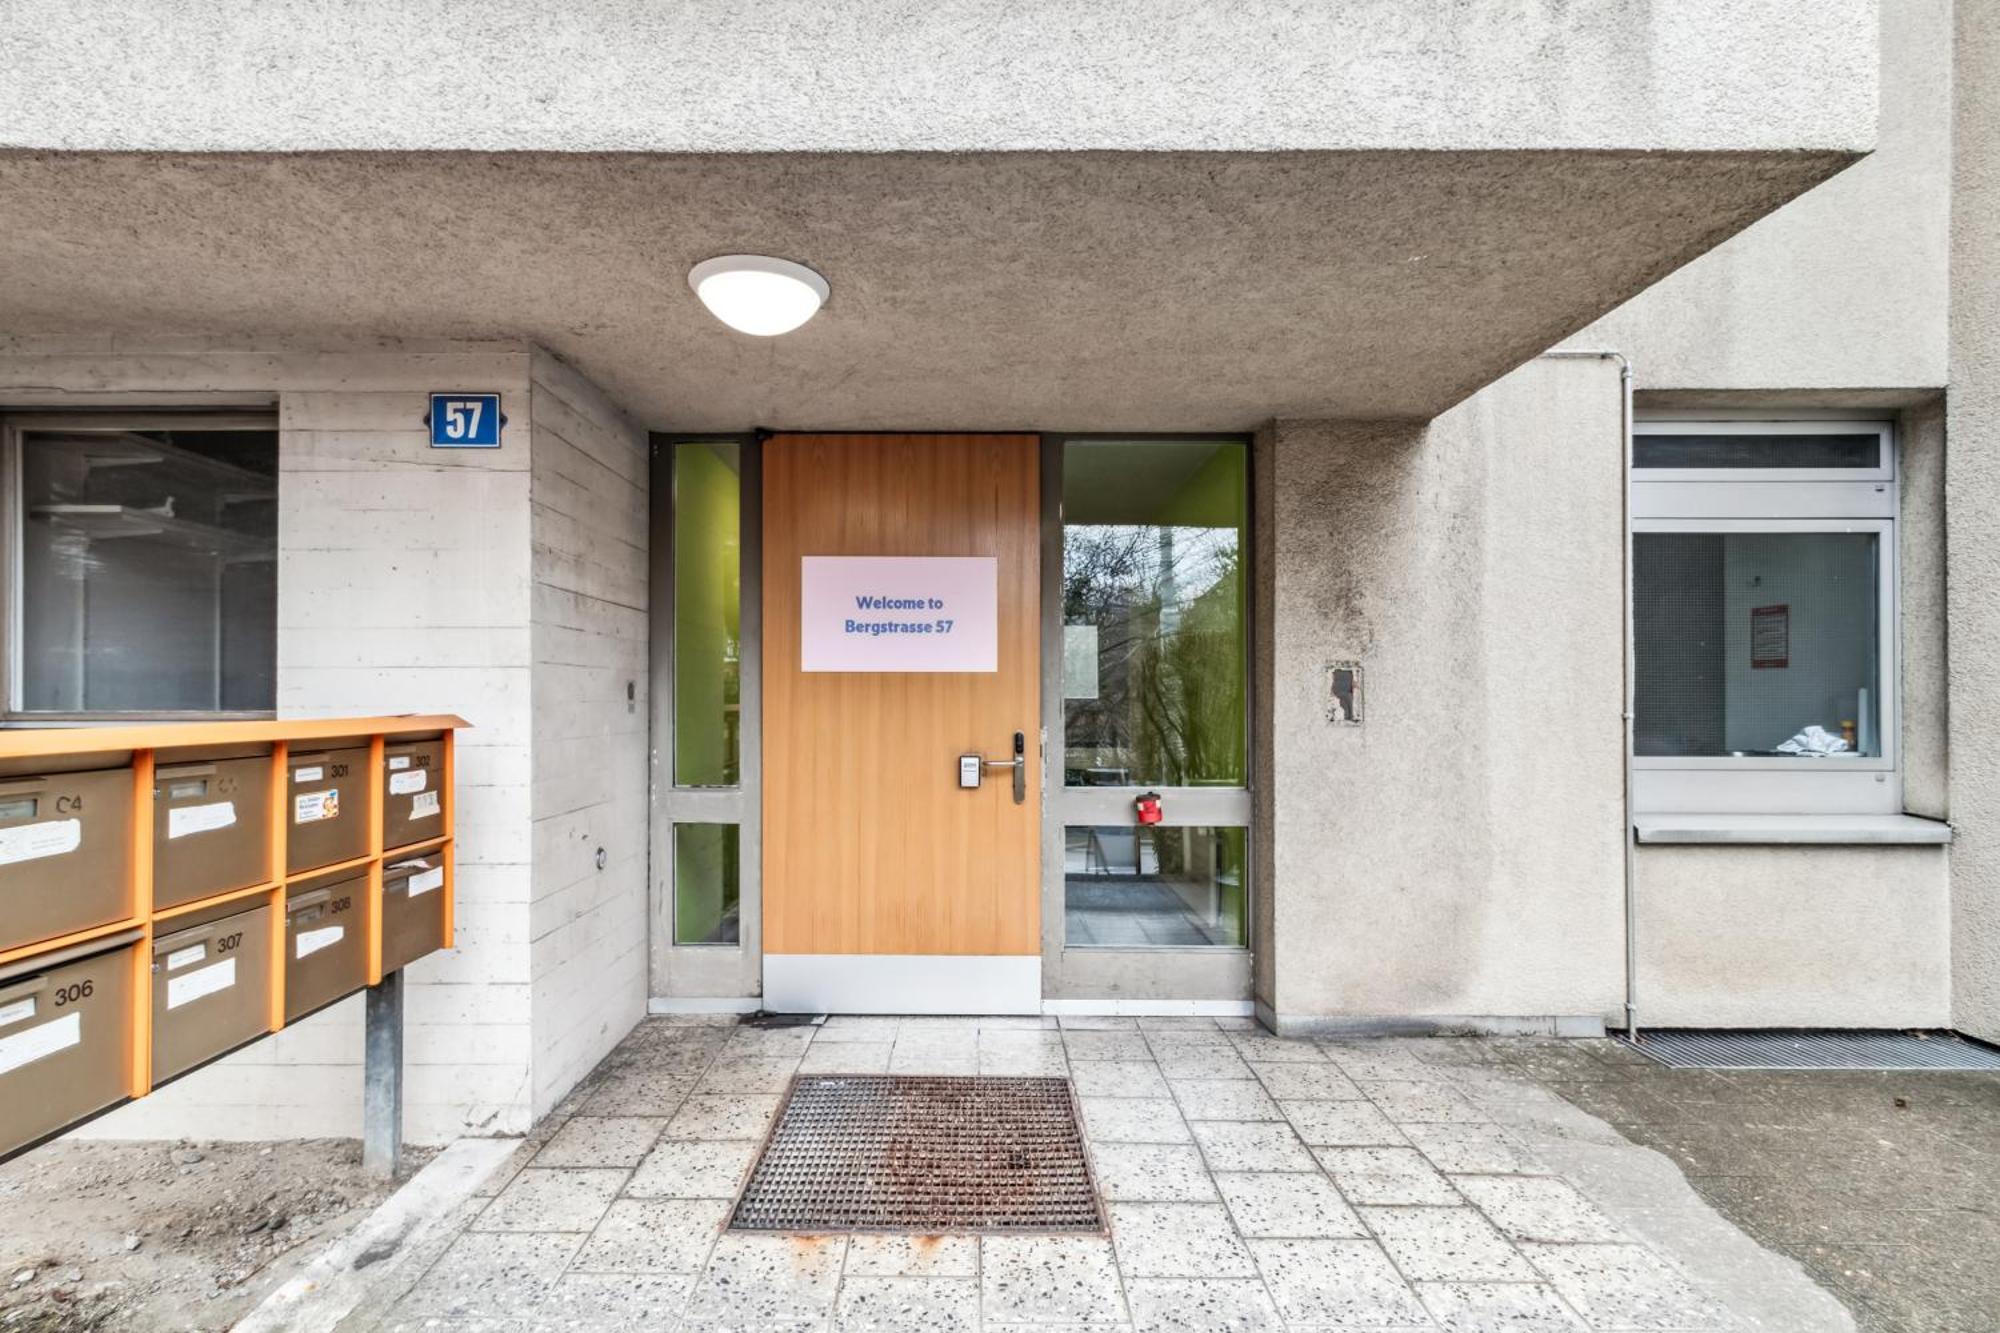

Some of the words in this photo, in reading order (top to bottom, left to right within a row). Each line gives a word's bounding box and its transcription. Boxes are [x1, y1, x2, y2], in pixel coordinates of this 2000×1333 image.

[446, 402, 482, 439] 57
[856, 596, 925, 610] Welcome
[928, 598, 943, 610] to
[844, 620, 932, 636] Bergstrasse
[936, 620, 953, 633] 57
[331, 764, 349, 778] 301
[56, 795, 82, 814] C4
[217, 932, 243, 953] 307
[54, 979, 94, 1007] 306
